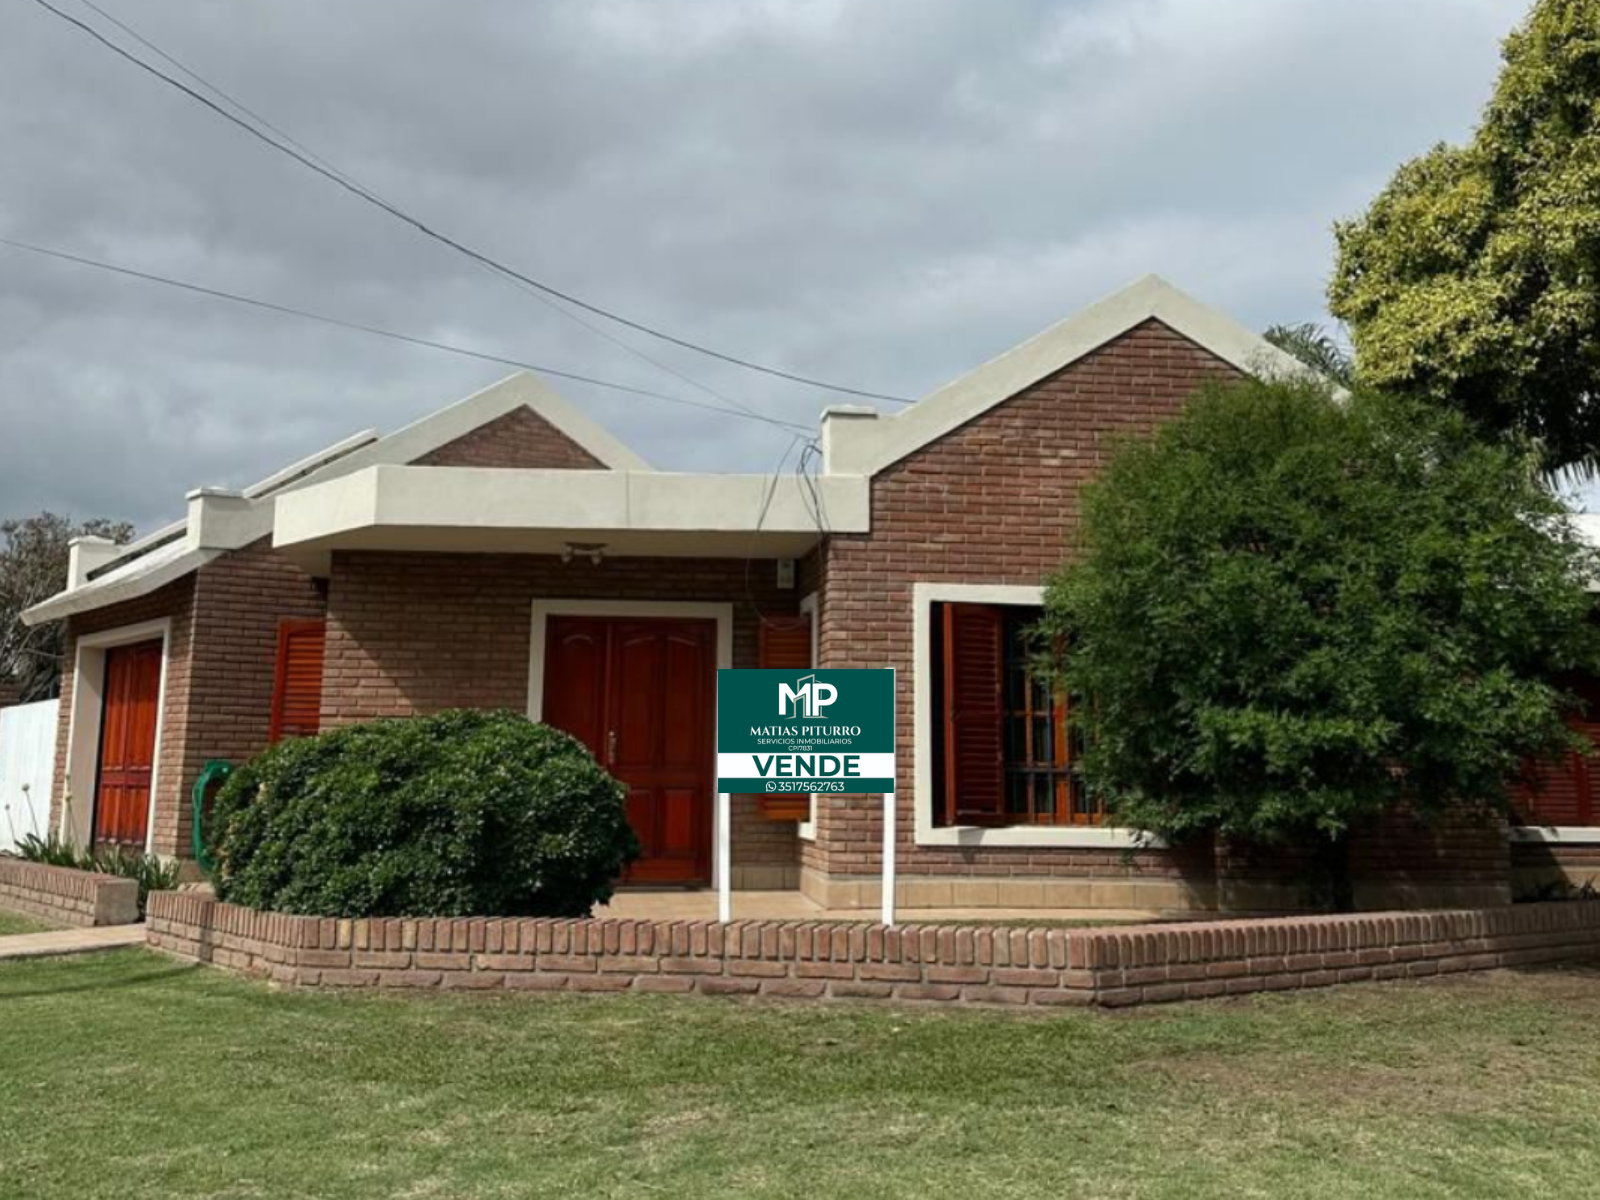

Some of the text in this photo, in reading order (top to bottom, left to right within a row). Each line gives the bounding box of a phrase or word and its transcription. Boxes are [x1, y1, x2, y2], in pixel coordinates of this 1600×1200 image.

[778, 683, 838, 717] MP
[750, 726, 861, 736] MATIAS PITURRO
[752, 755, 861, 777] VENDE
[778, 781, 845, 791] 3517562763
